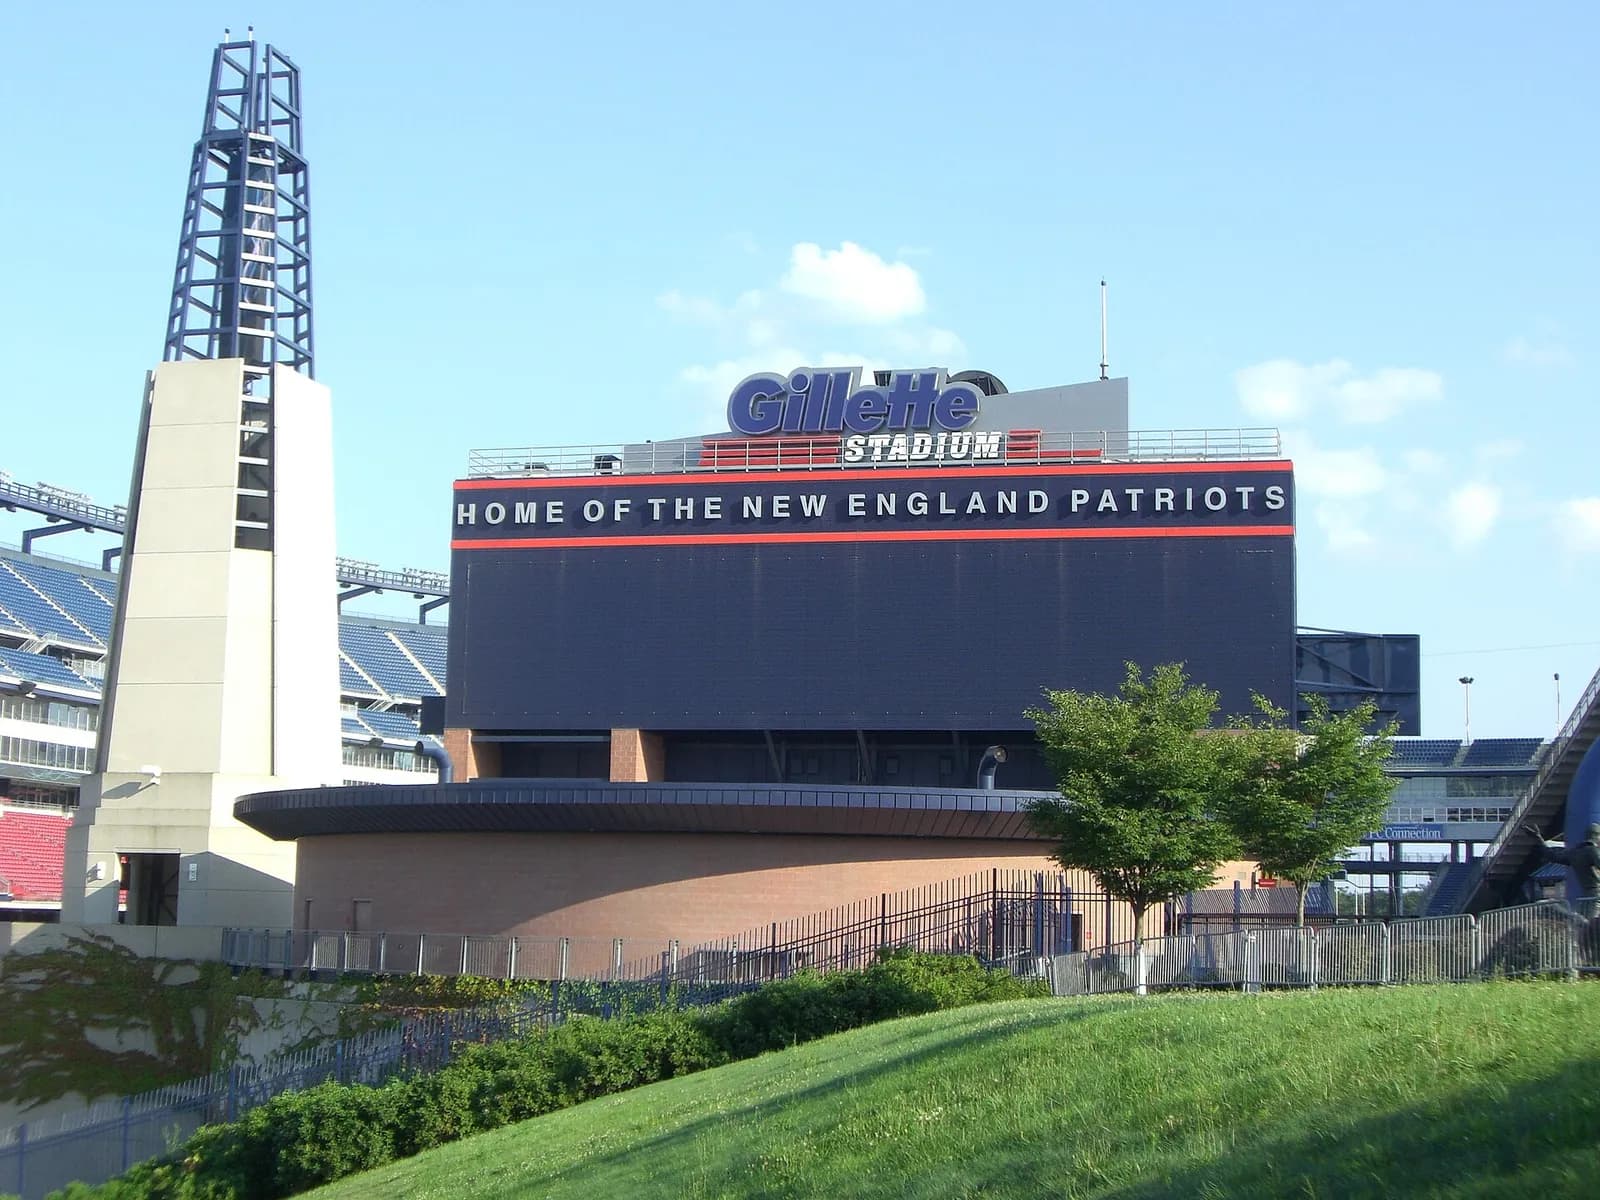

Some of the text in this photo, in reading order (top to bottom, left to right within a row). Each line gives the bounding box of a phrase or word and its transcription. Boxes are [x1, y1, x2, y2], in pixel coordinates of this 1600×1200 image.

[730, 370, 981, 434] Gillette
[844, 431, 1002, 462] STADIUM
[456, 484, 1286, 526] HOME OF THE NEW ENGLAND PATRIOTS
[1385, 827, 1441, 840] Connection
